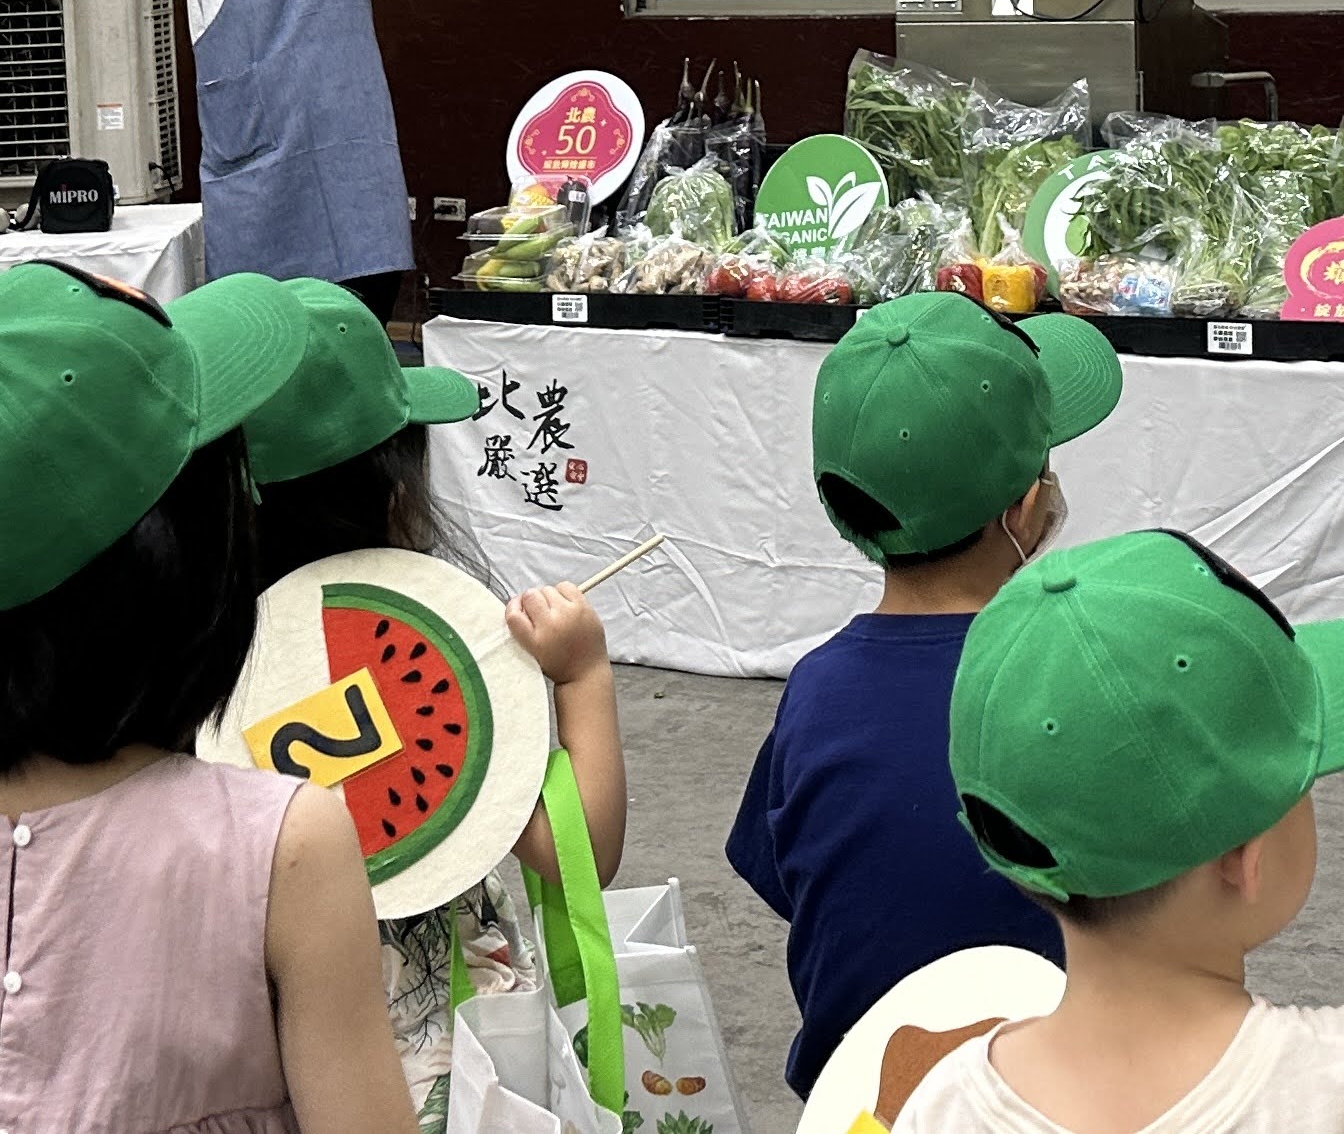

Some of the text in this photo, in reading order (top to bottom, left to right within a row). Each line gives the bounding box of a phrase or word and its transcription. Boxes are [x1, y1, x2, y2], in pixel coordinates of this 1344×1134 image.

[555, 124, 597, 156] 50
[472, 368, 576, 455] 北農
[269, 683, 383, 780] 2
